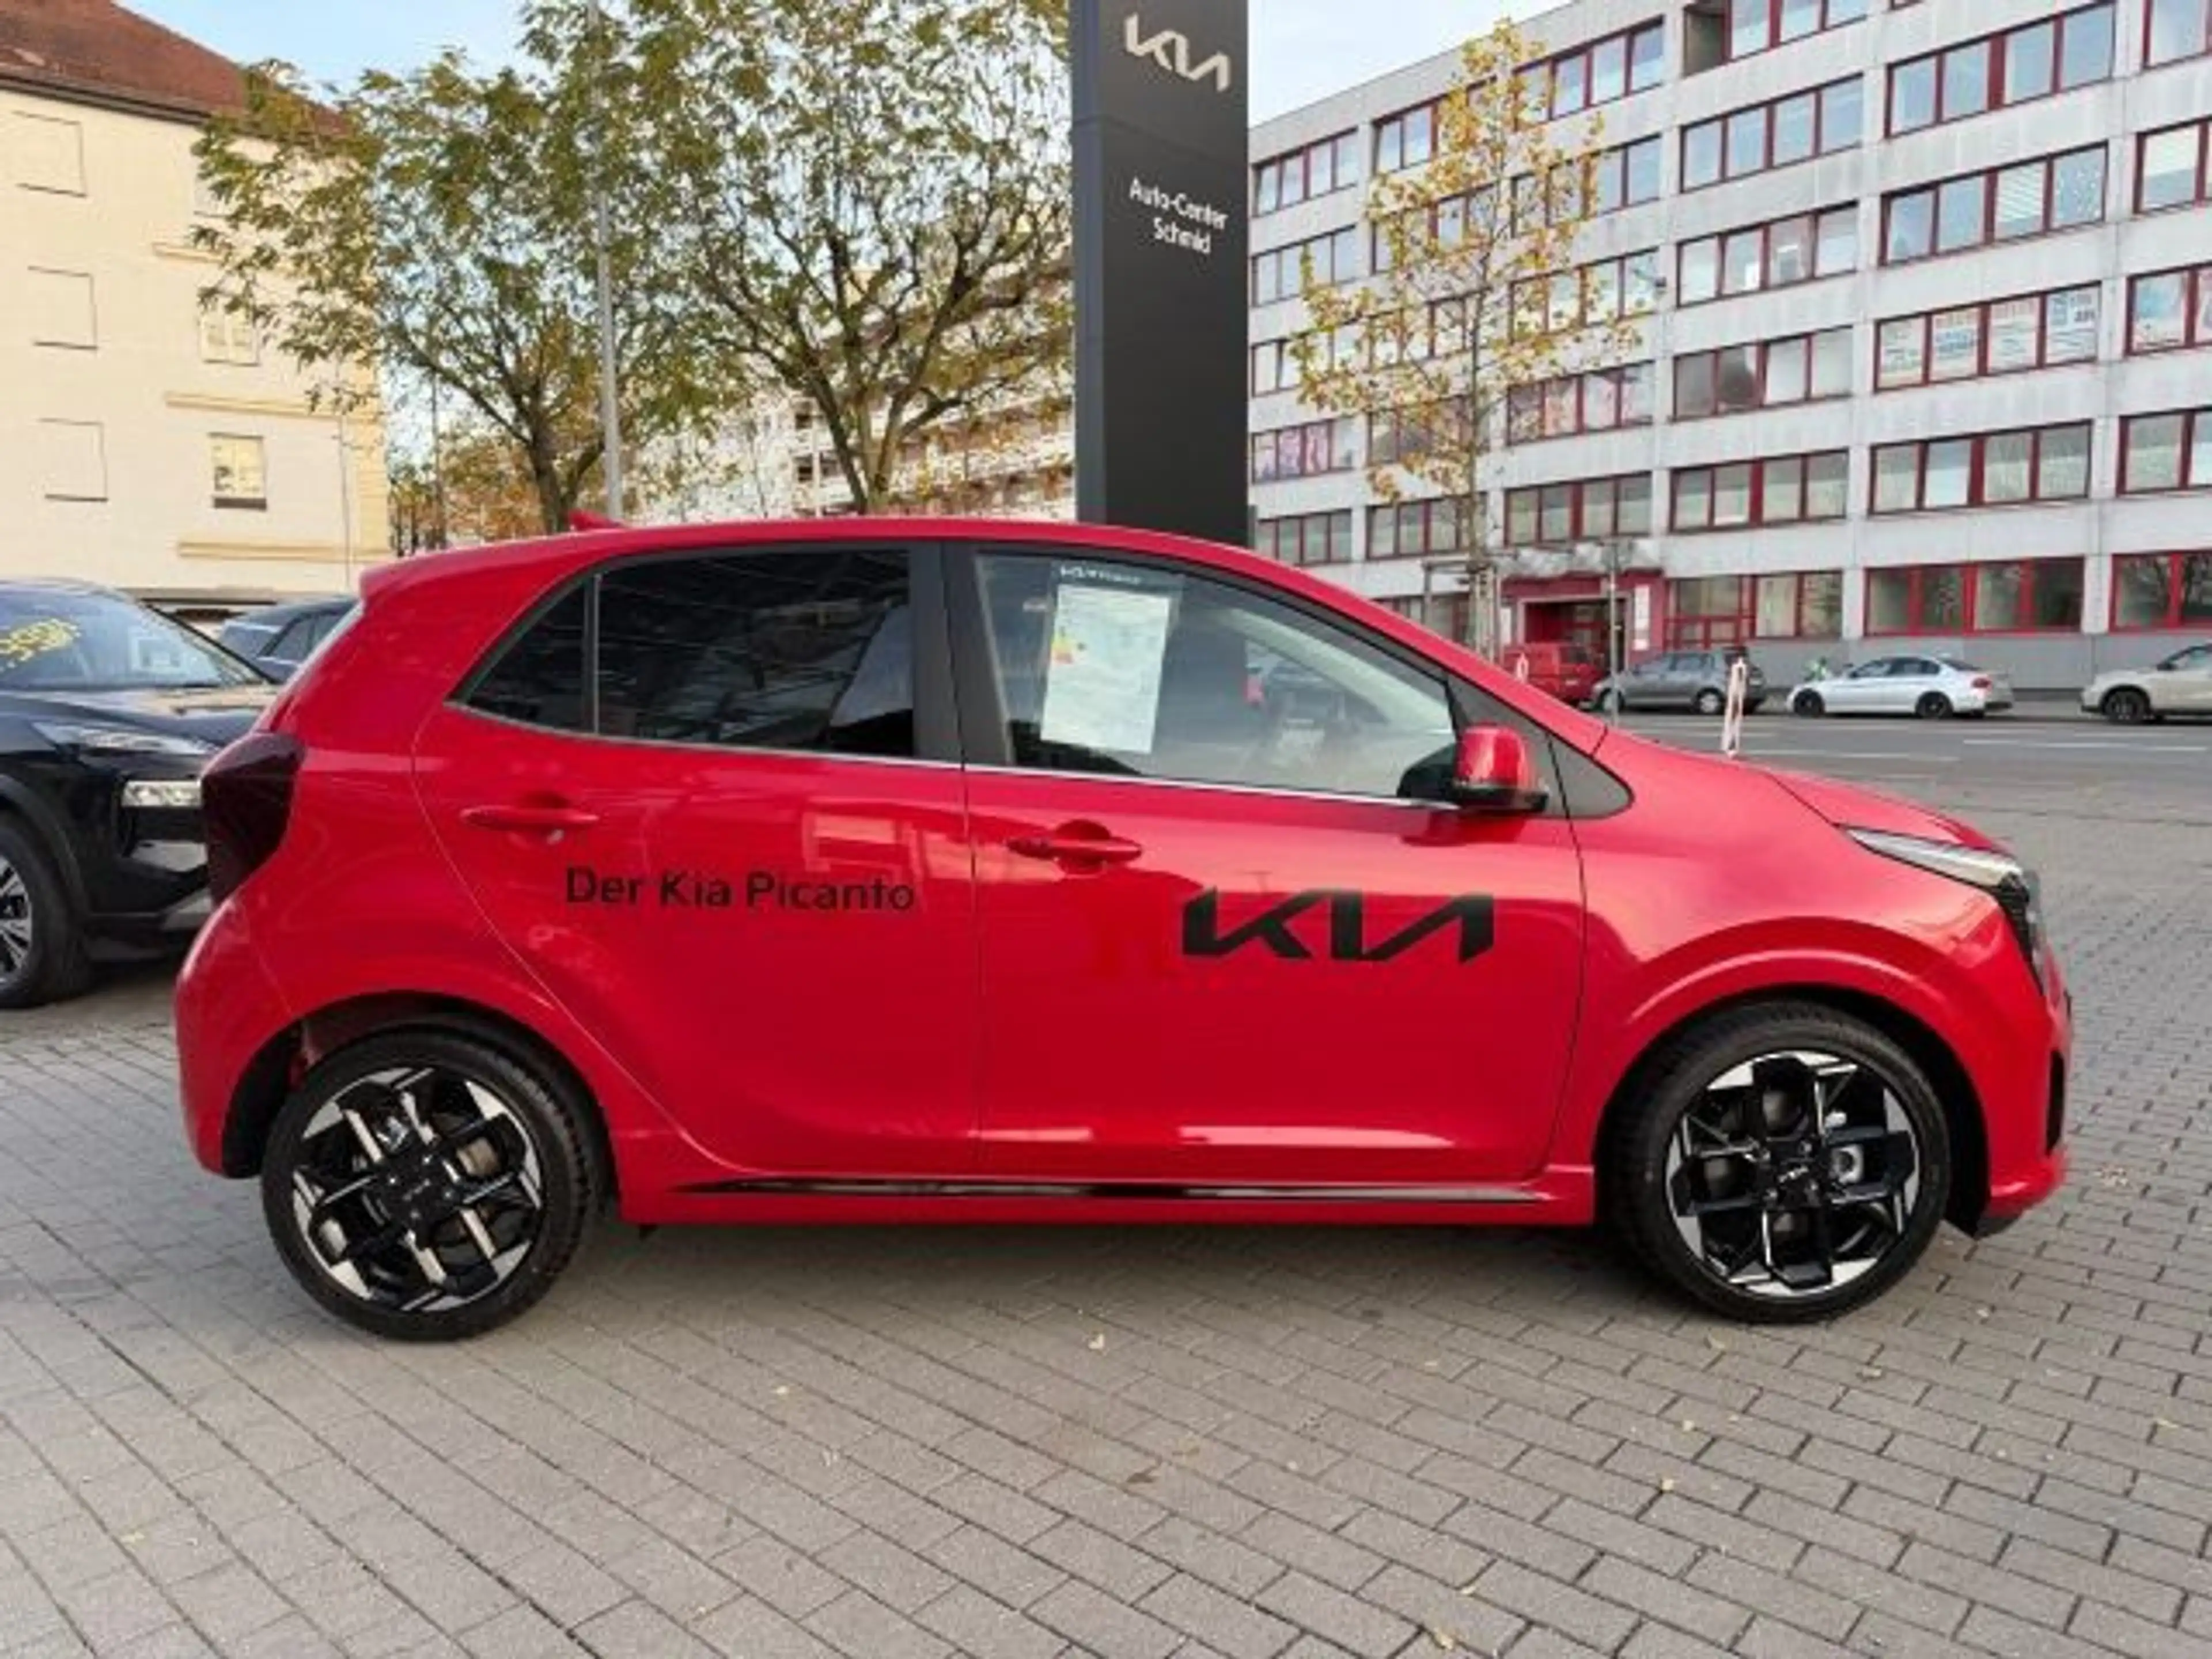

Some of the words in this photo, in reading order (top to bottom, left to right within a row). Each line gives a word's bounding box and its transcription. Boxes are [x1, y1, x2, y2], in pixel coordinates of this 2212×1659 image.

[1130, 176, 1229, 230] Auto-Center
[1154, 218, 1211, 253] Schmid
[565, 864, 644, 905] Der
[660, 869, 732, 908] Kia
[747, 871, 916, 911] Picanto
[1183, 887, 1494, 962] KIA
